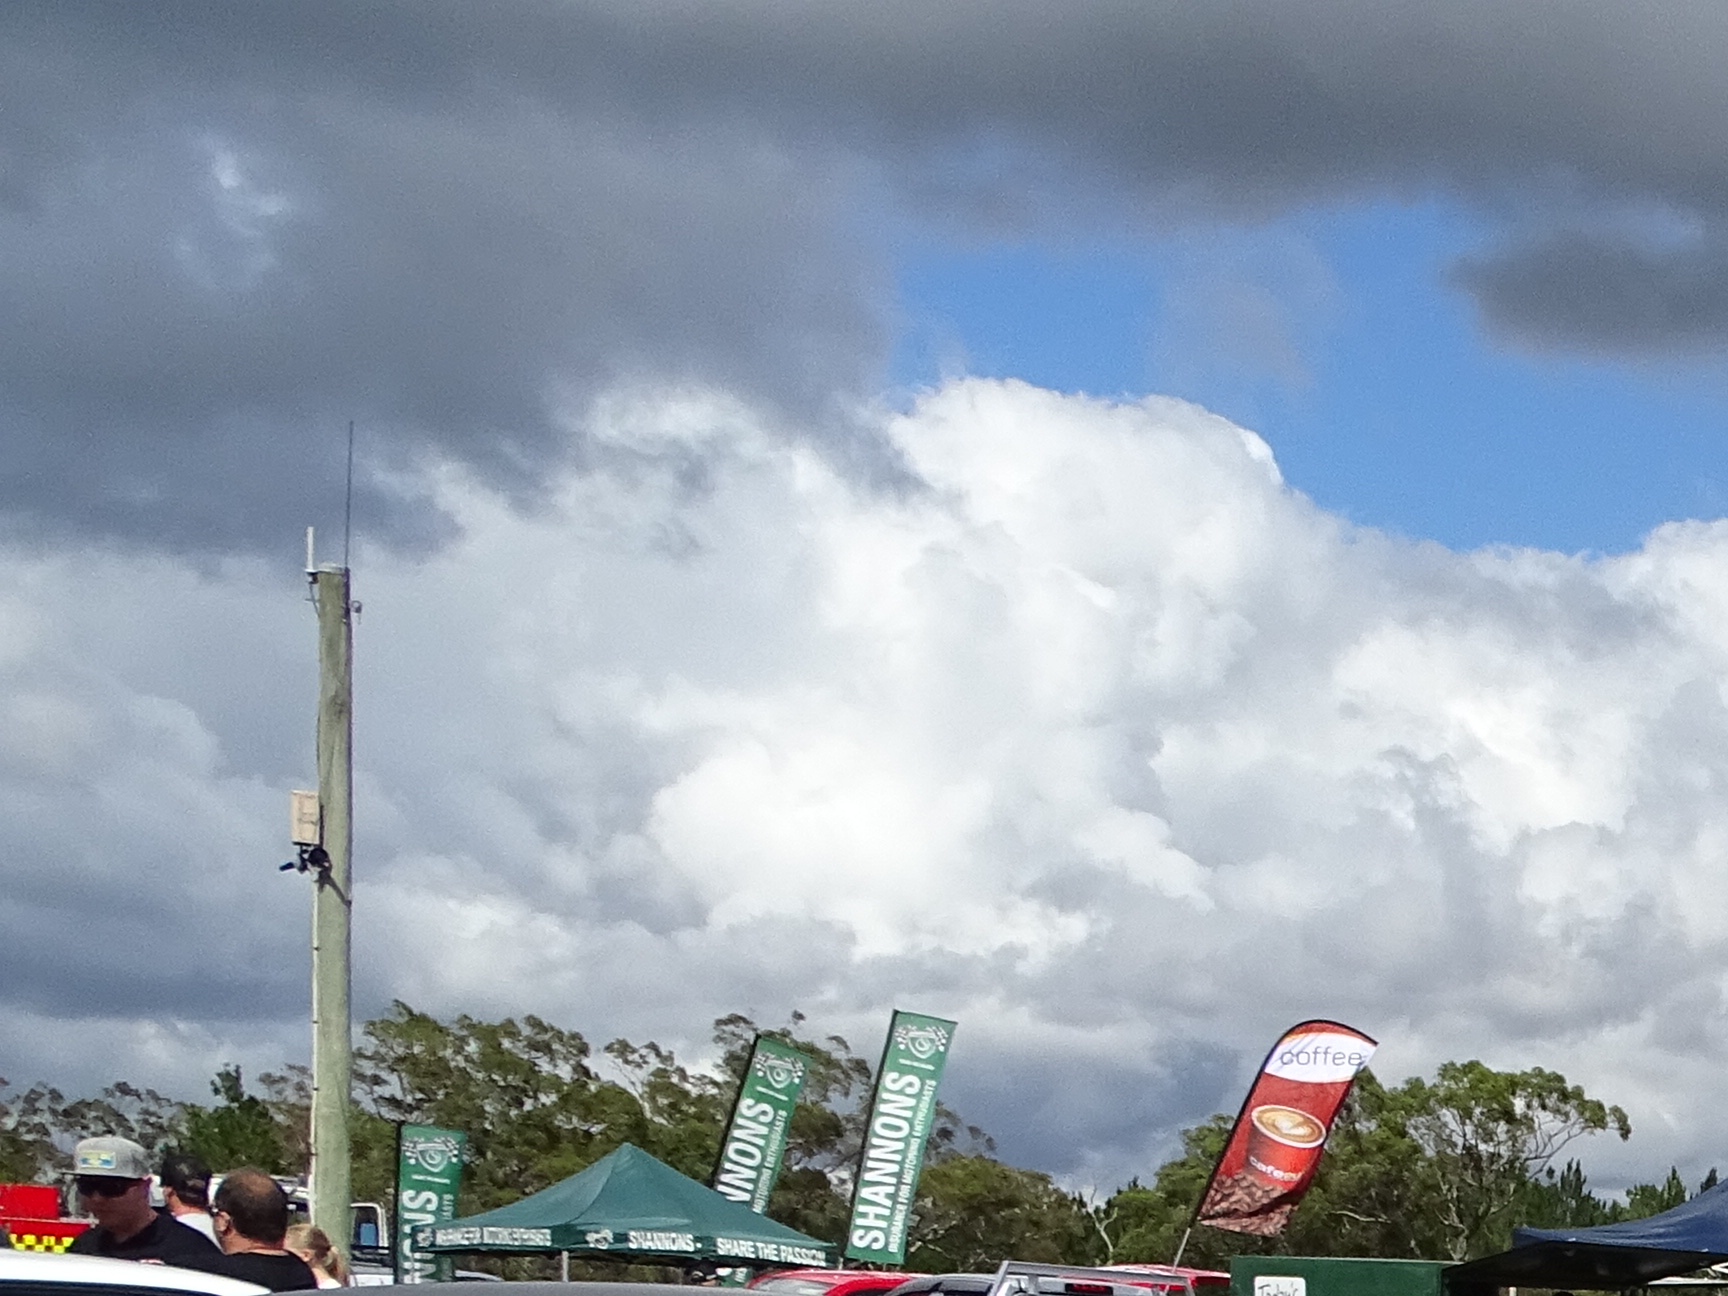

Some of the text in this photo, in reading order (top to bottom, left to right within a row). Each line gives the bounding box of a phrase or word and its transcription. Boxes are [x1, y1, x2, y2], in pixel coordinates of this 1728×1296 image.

[1280, 1046, 1363, 1067] coffee
[852, 1071, 922, 1251] SHANNONS
[716, 1237, 755, 1259] SHARE
[756, 1243, 779, 1261] THE
